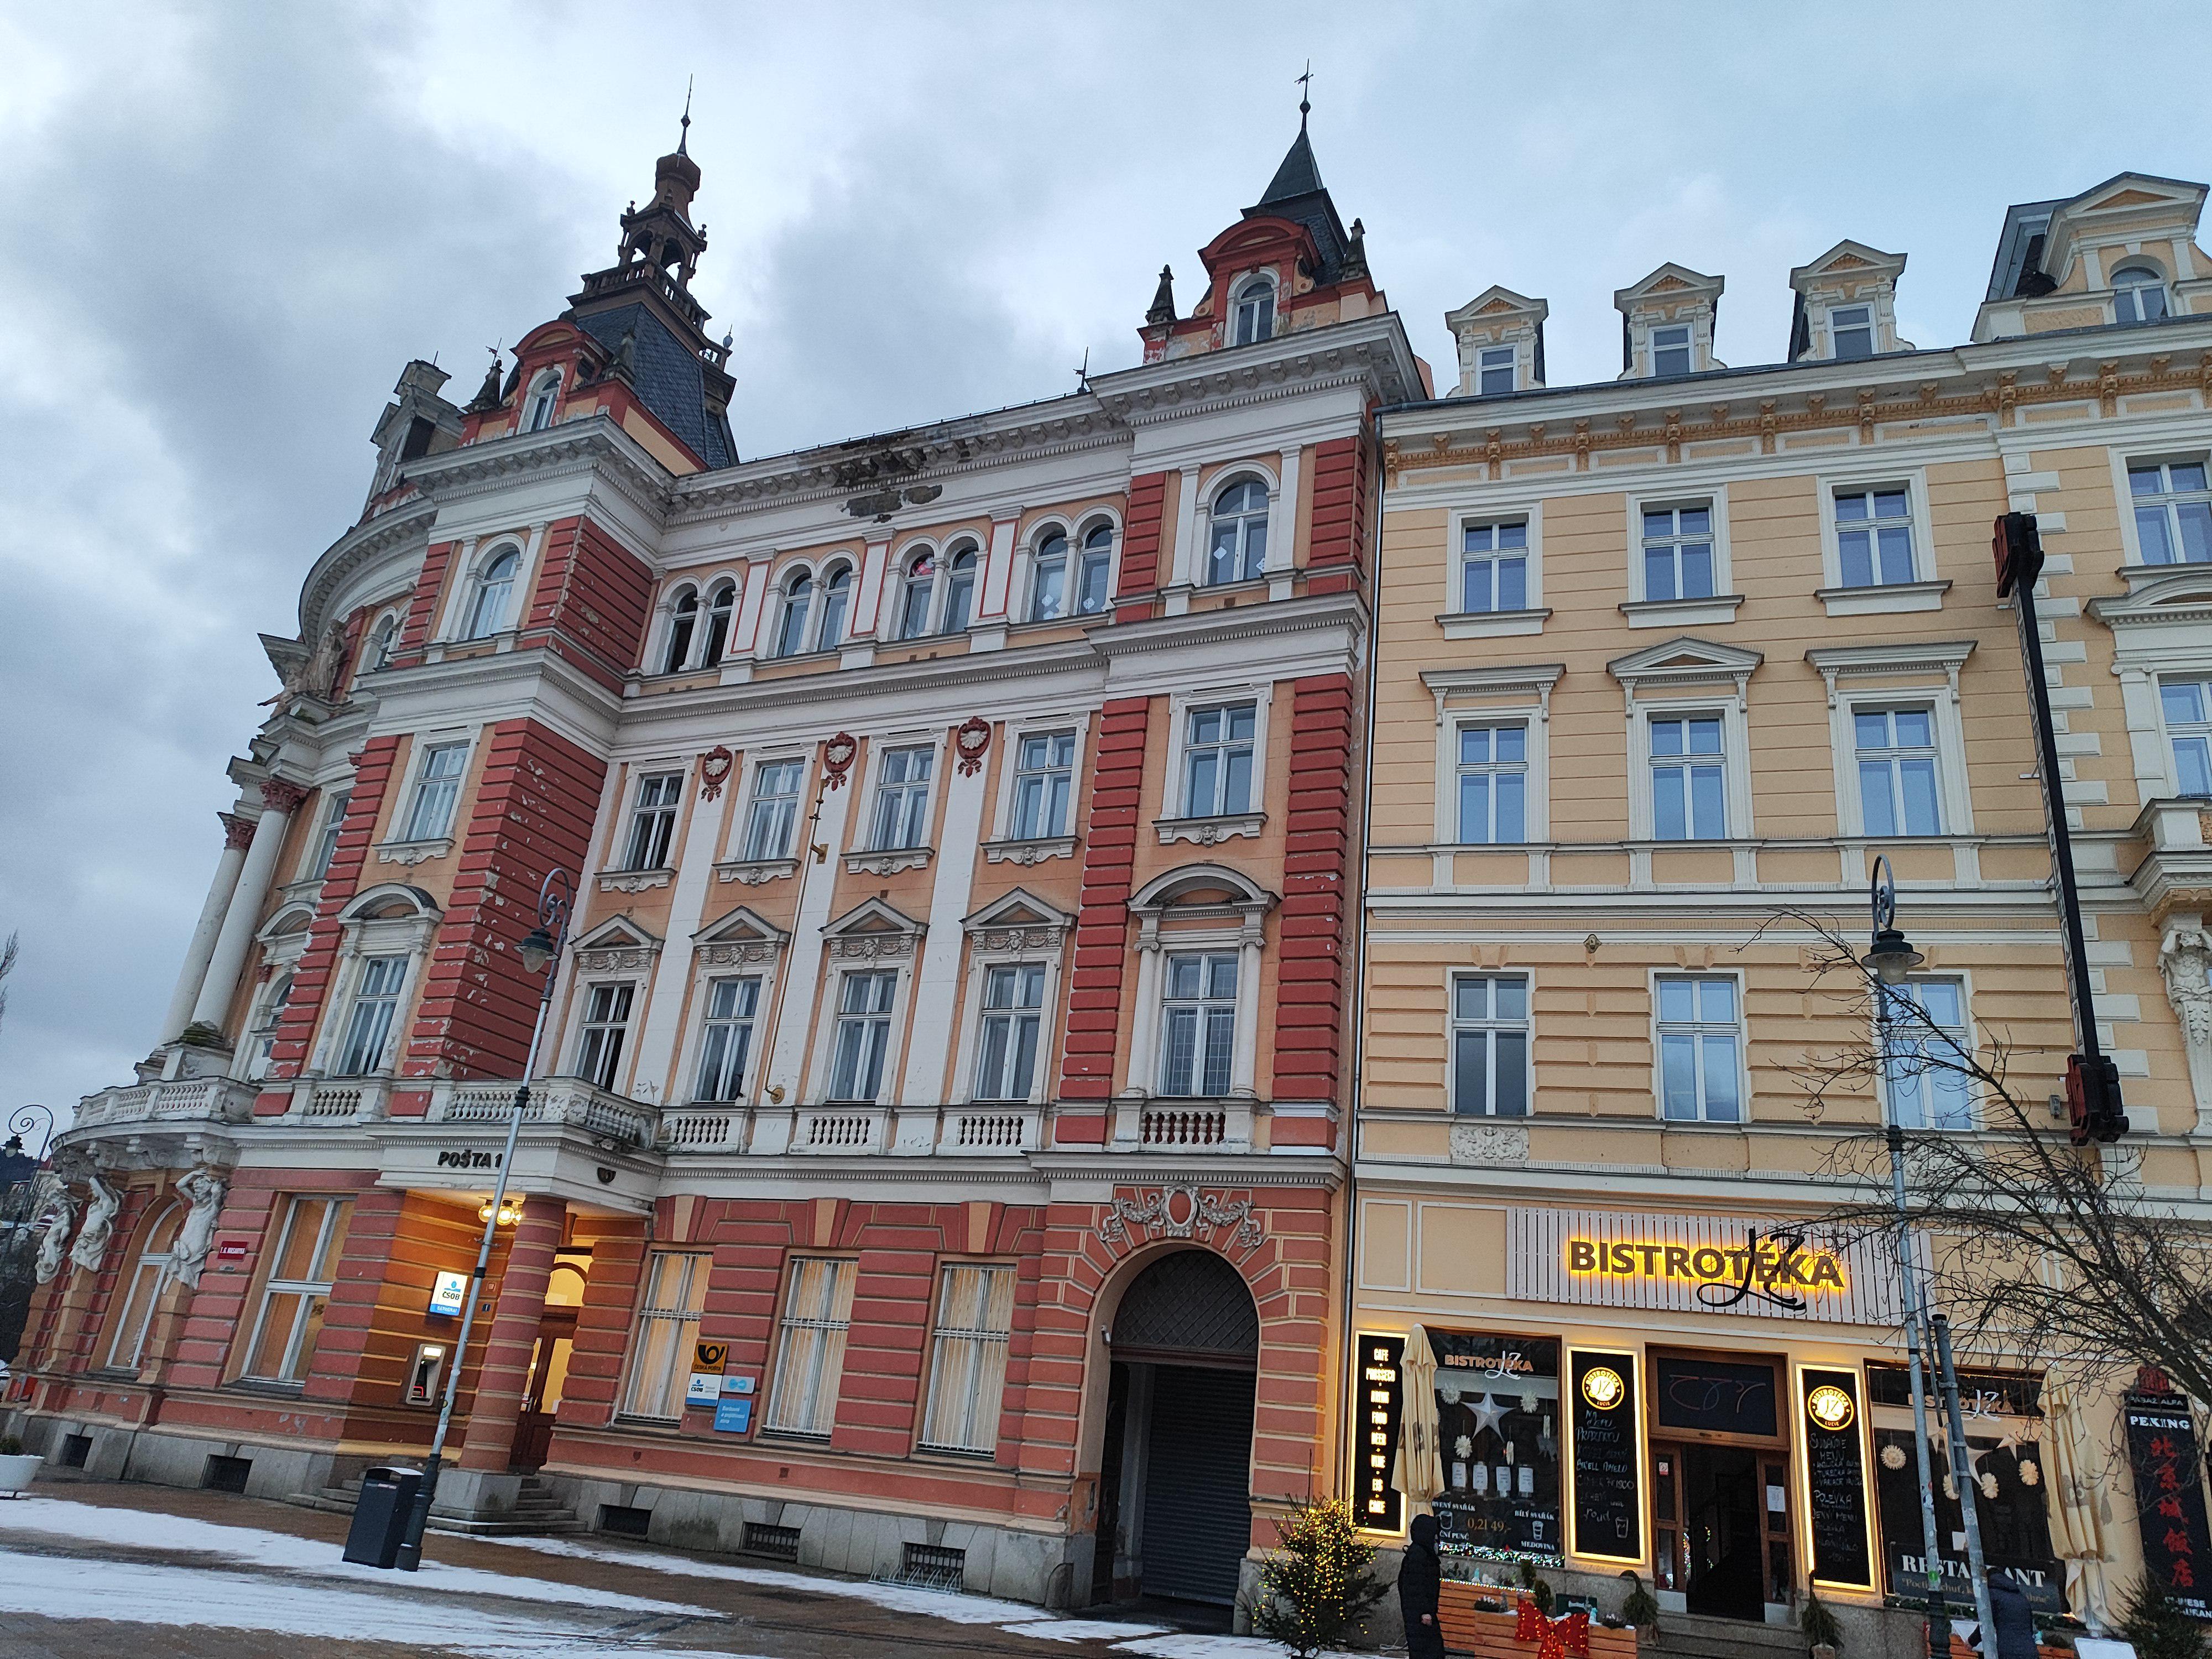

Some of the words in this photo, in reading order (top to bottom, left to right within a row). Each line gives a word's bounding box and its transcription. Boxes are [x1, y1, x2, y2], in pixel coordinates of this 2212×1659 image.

[437, 1149, 491, 1168] POŠTA
[495, 1153, 503, 1168] 1
[1571, 1241, 1845, 1287] BISTROTÉKA
[1444, 1354, 1534, 1372] BISTROTÉKA
[1908, 1393, 2015, 1413] STOTÉKA
[2130, 1416, 2190, 1430] PEKING
[1521, 1541, 1555, 1551] MEDOVINA
[1902, 1554, 2046, 1588] RESTAANT
